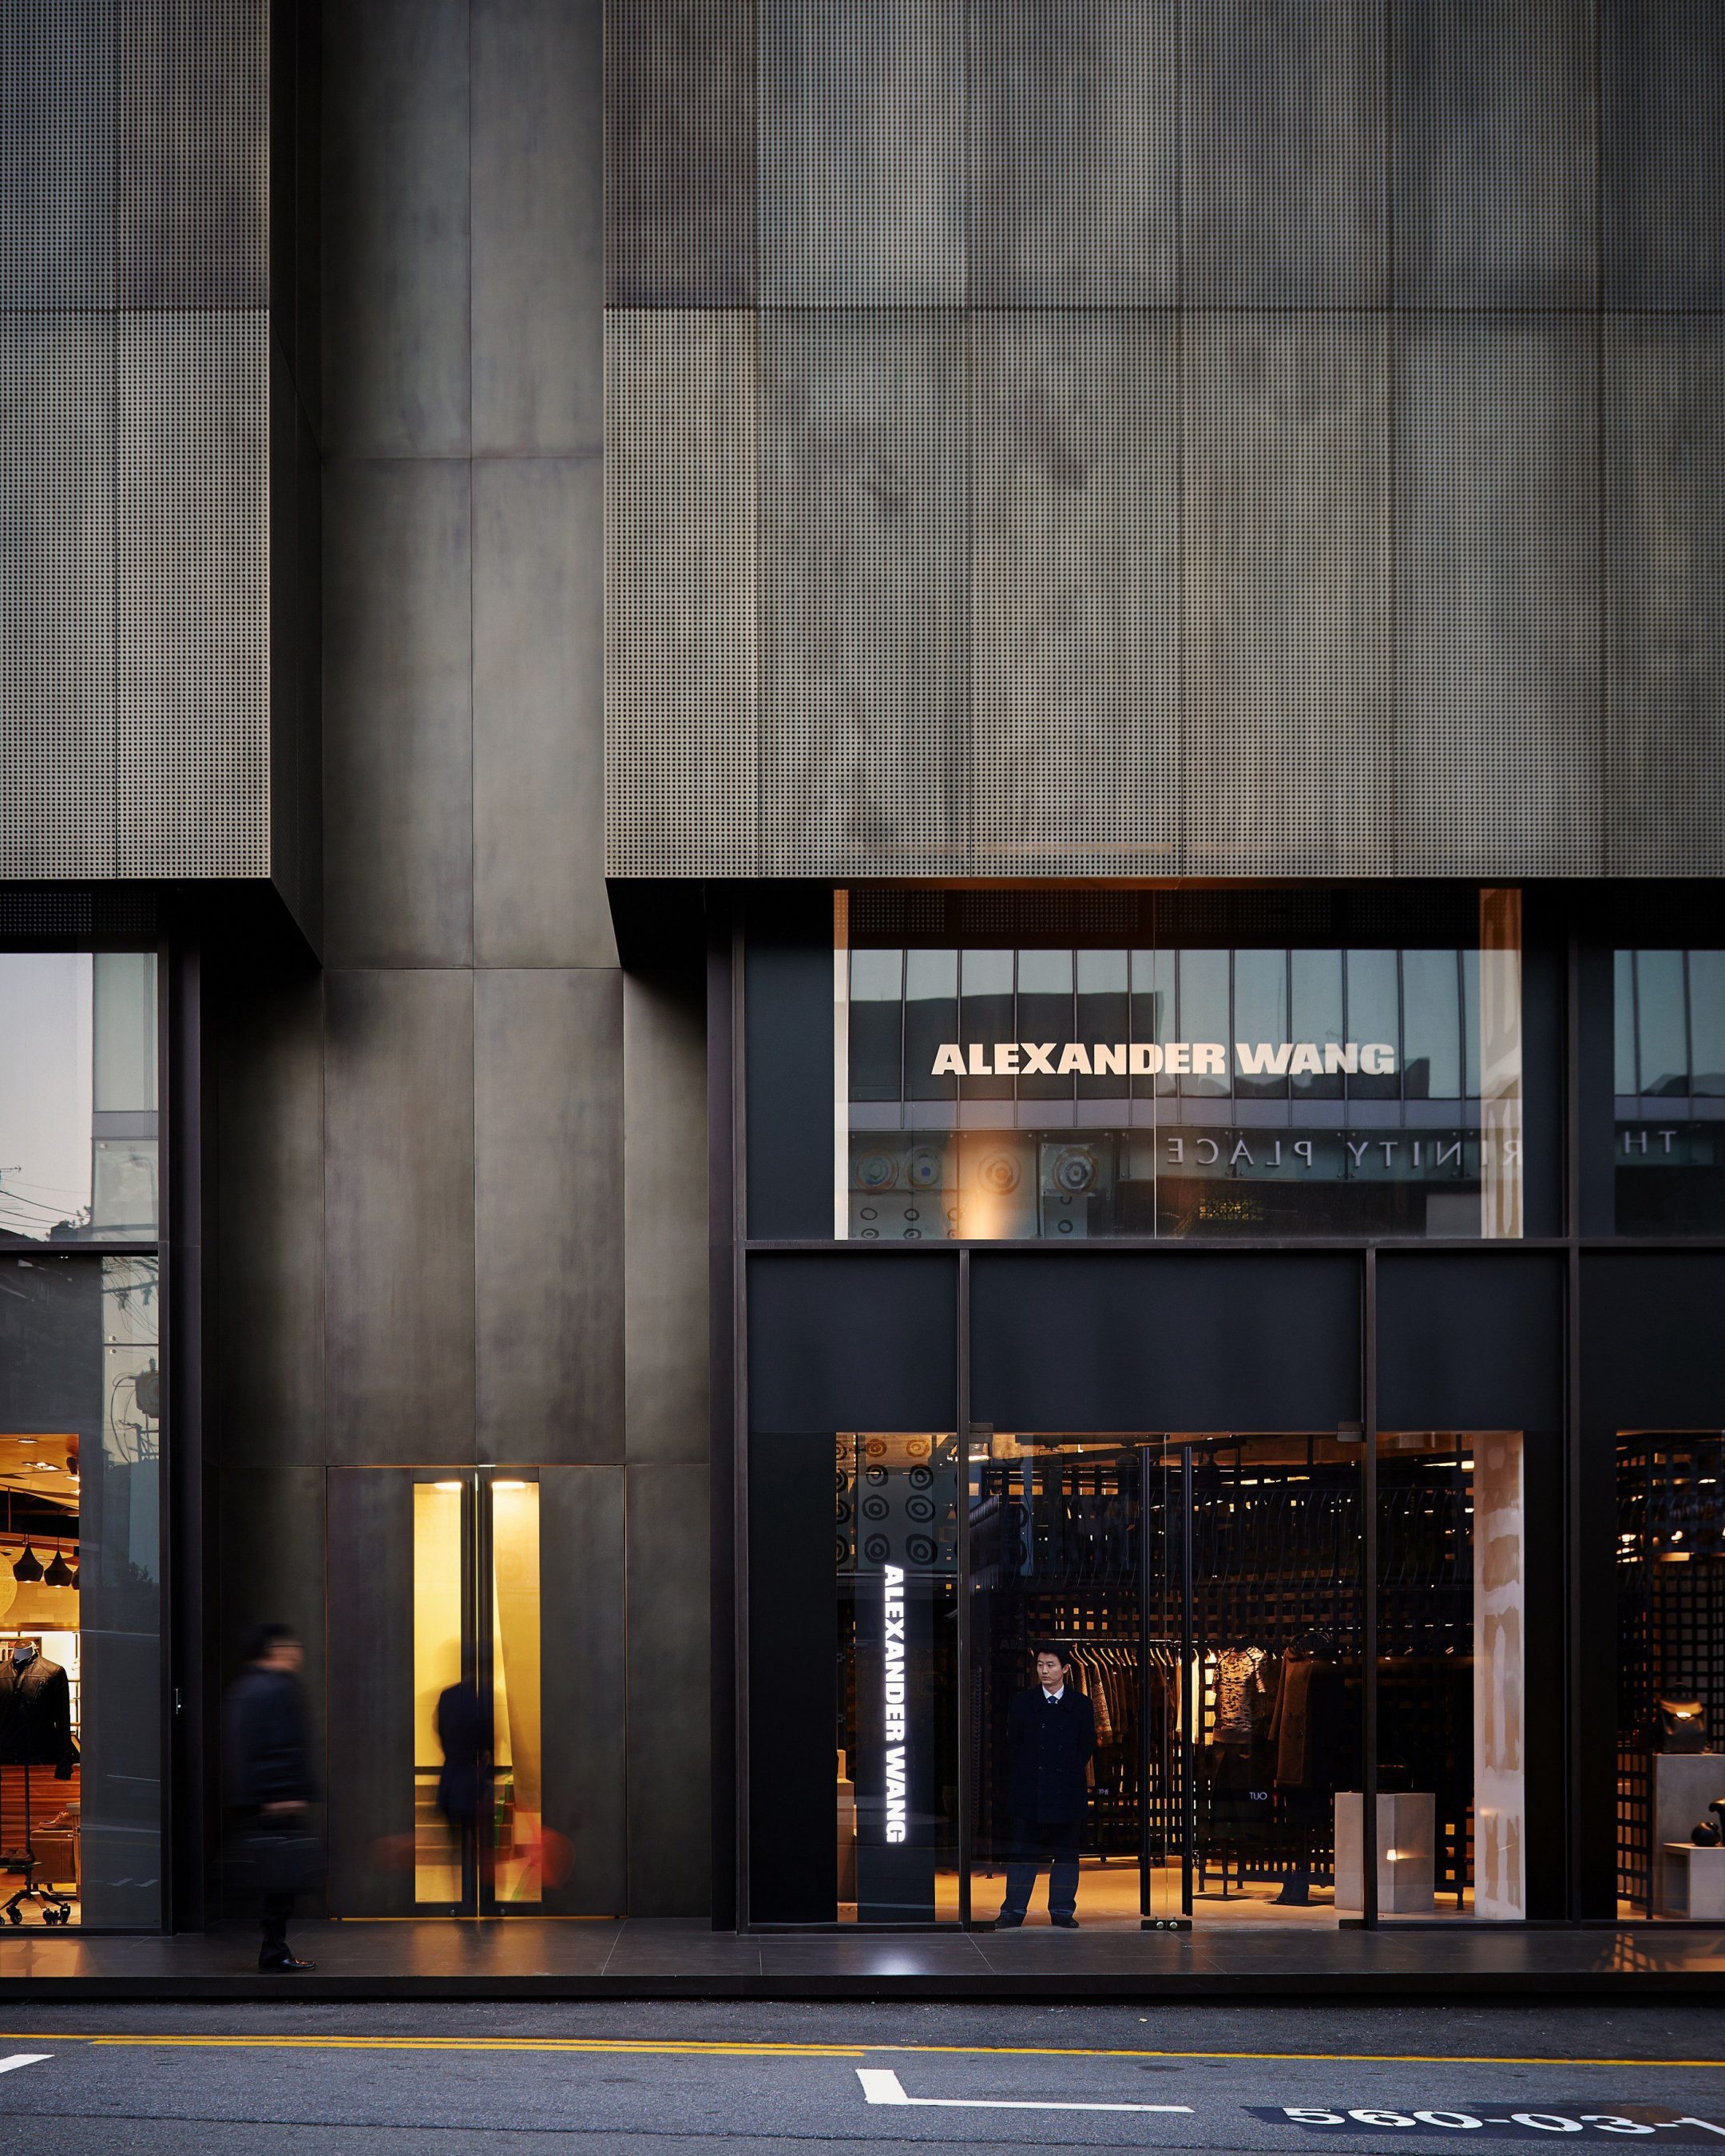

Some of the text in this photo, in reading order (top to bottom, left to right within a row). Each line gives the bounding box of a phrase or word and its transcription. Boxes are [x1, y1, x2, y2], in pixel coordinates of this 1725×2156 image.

[930, 1043, 1395, 1076] ALEXANDER WANG
[884, 1564, 906, 1843] ALEXANDER WANG
[1282, 2107, 1725, 2137] 560-03-1
